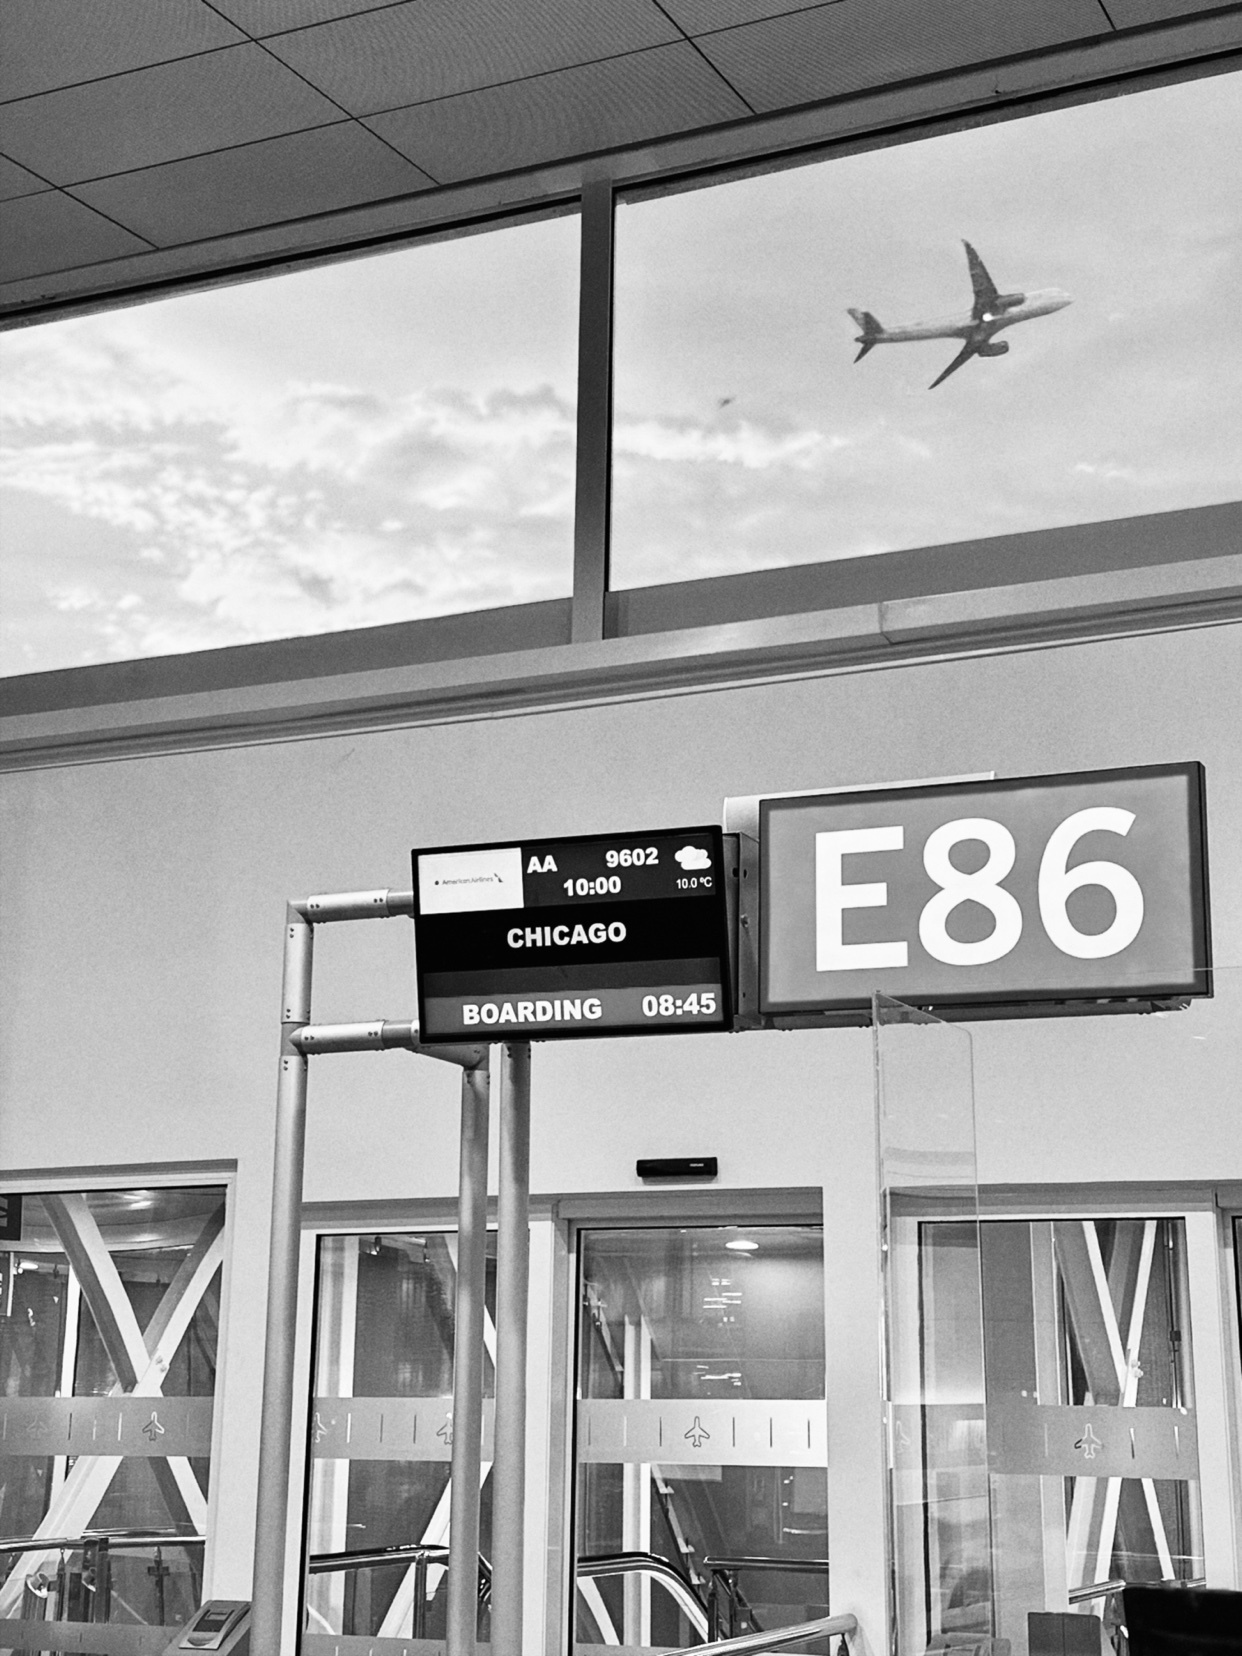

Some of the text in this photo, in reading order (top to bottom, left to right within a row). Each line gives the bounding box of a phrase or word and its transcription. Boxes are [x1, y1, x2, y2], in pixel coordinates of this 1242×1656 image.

[526, 846, 659, 874] AA 9602
[441, 878, 470, 886] American
[563, 875, 622, 897] 10:00
[676, 877, 698, 889] 10.0
[815, 807, 1144, 972] E86
[507, 921, 627, 949] CHICAGO
[462, 992, 716, 1026] BOARDING 08:45
